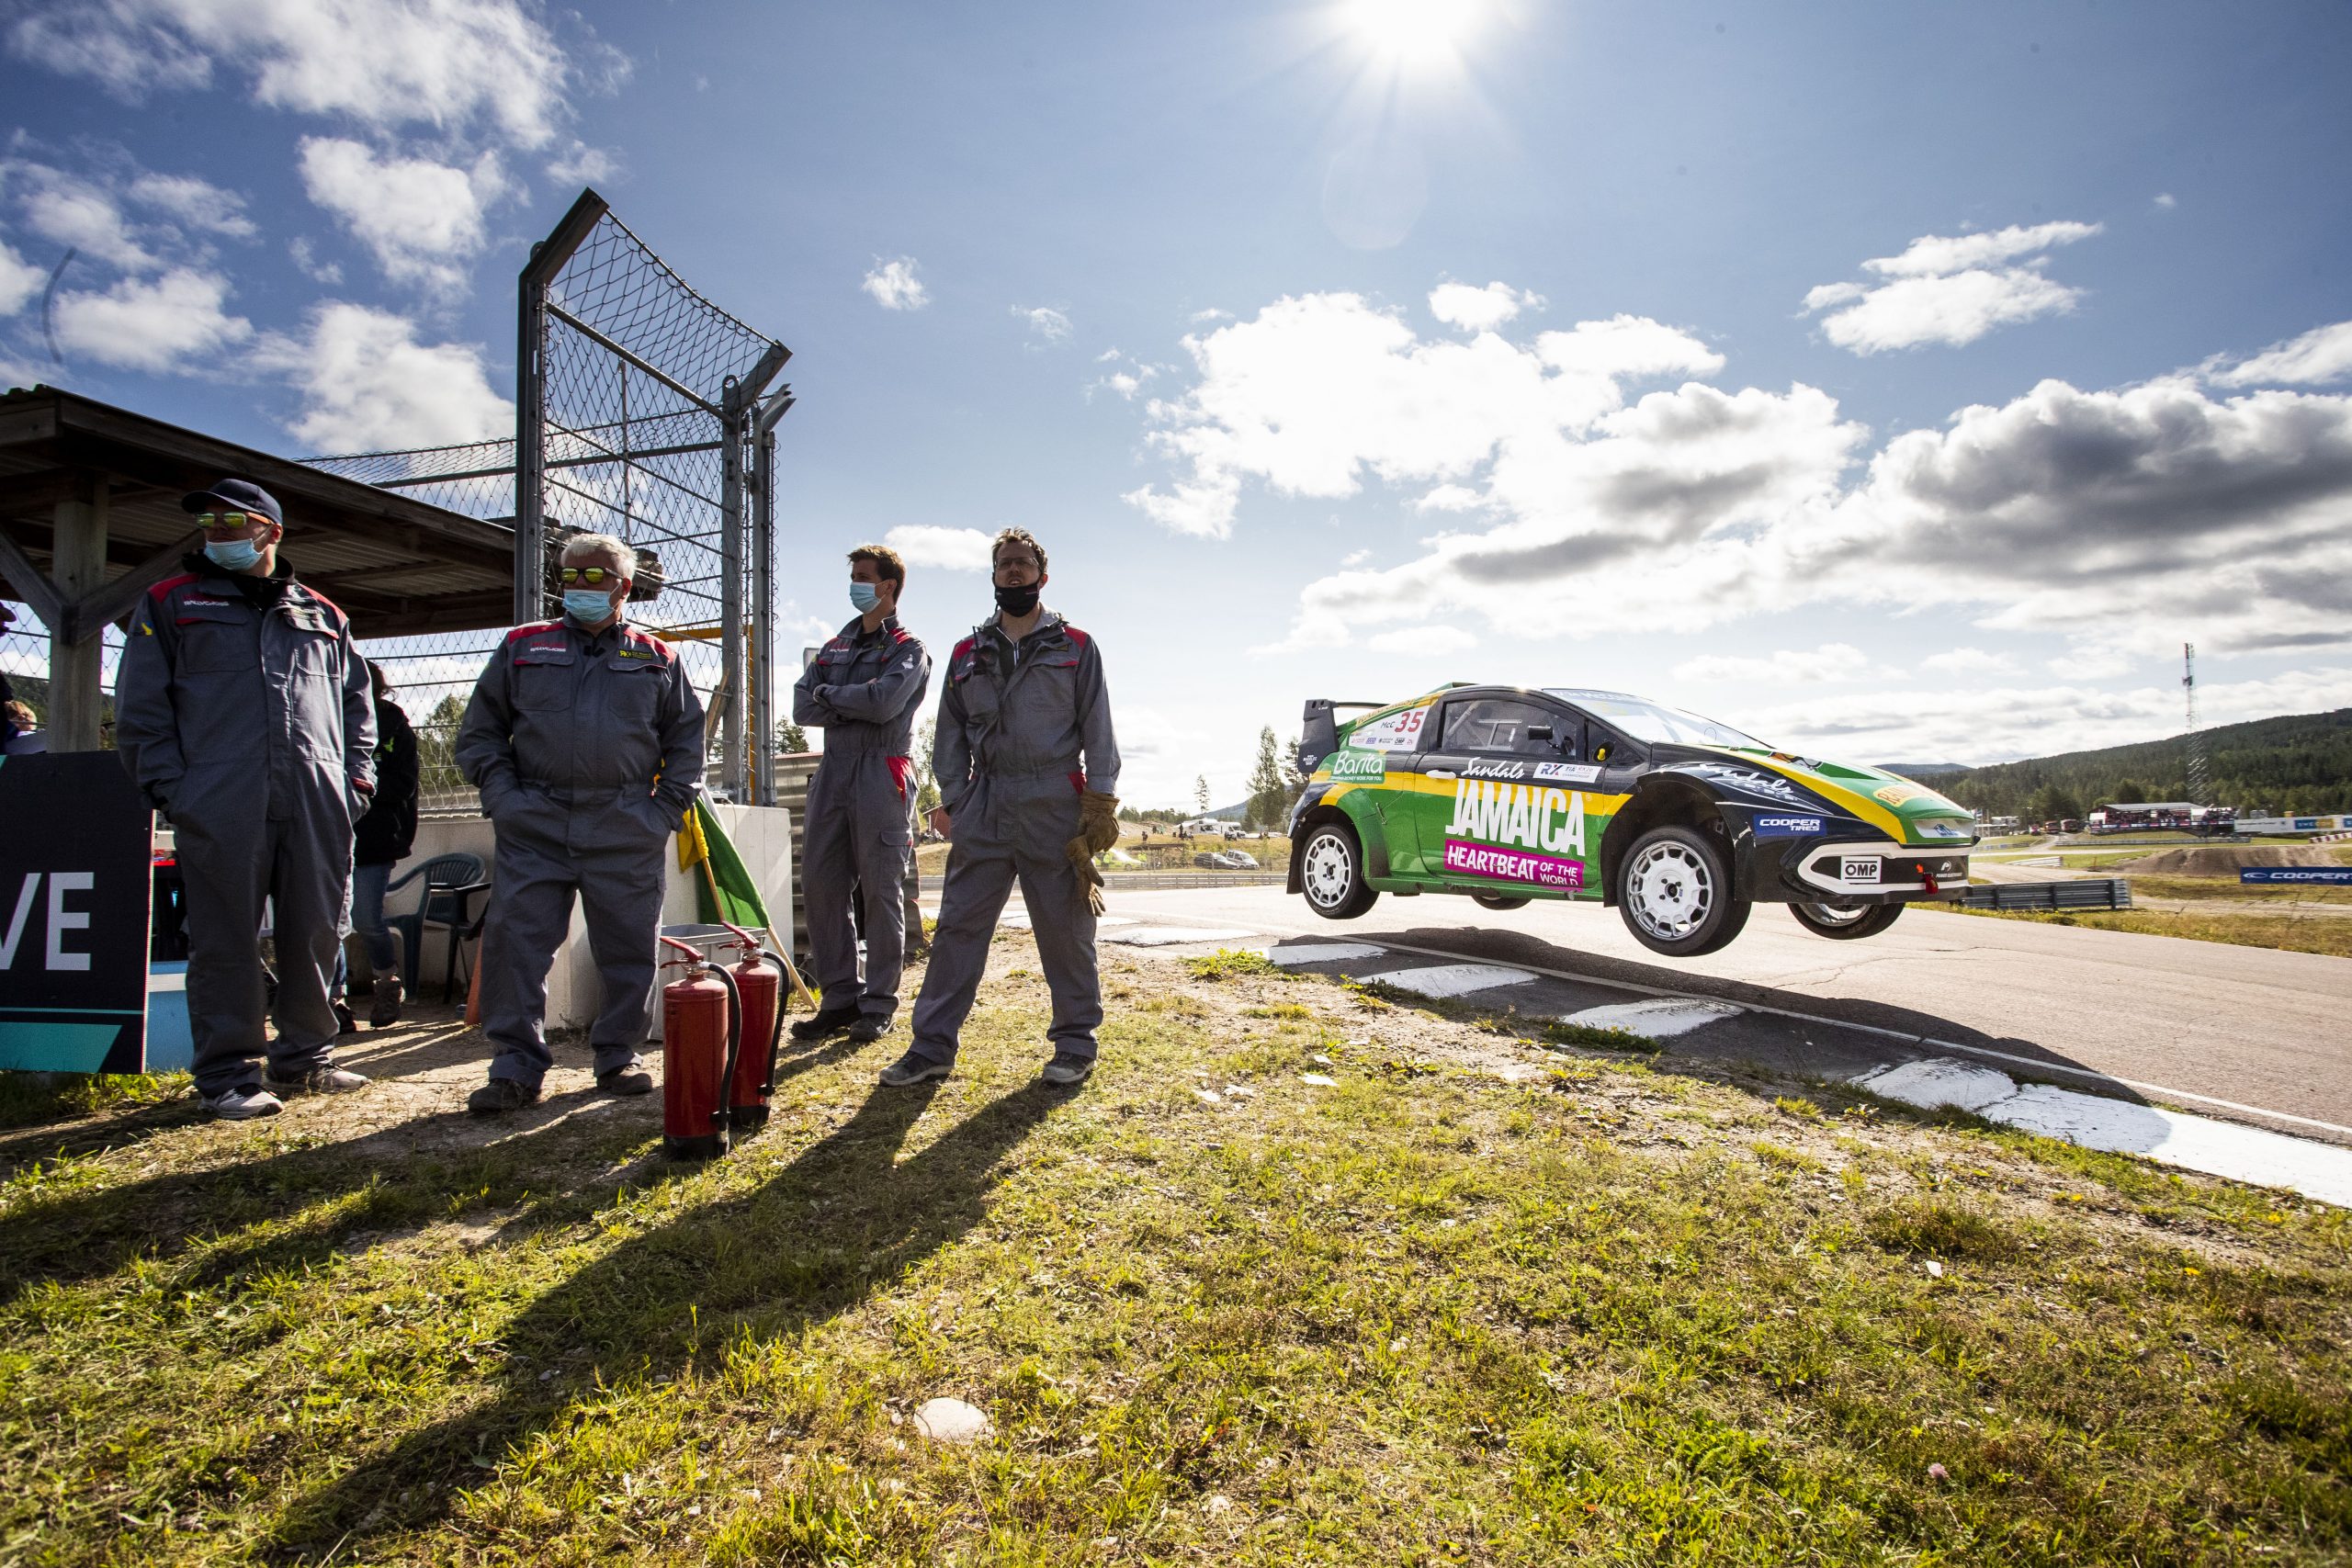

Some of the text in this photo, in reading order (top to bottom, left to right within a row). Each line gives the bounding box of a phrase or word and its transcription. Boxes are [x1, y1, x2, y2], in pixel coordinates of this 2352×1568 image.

[1394, 711, 1425, 733] 35
[1333, 750, 1383, 774] Barita
[1460, 756, 1525, 779] Sandals
[1445, 778, 1586, 857] JAMAICA
[1759, 818, 1821, 827] COOPER
[1447, 844, 1538, 881] HEARTBEAT
[1540, 862, 1578, 877] OF THE
[1845, 864, 1878, 876] OMP
